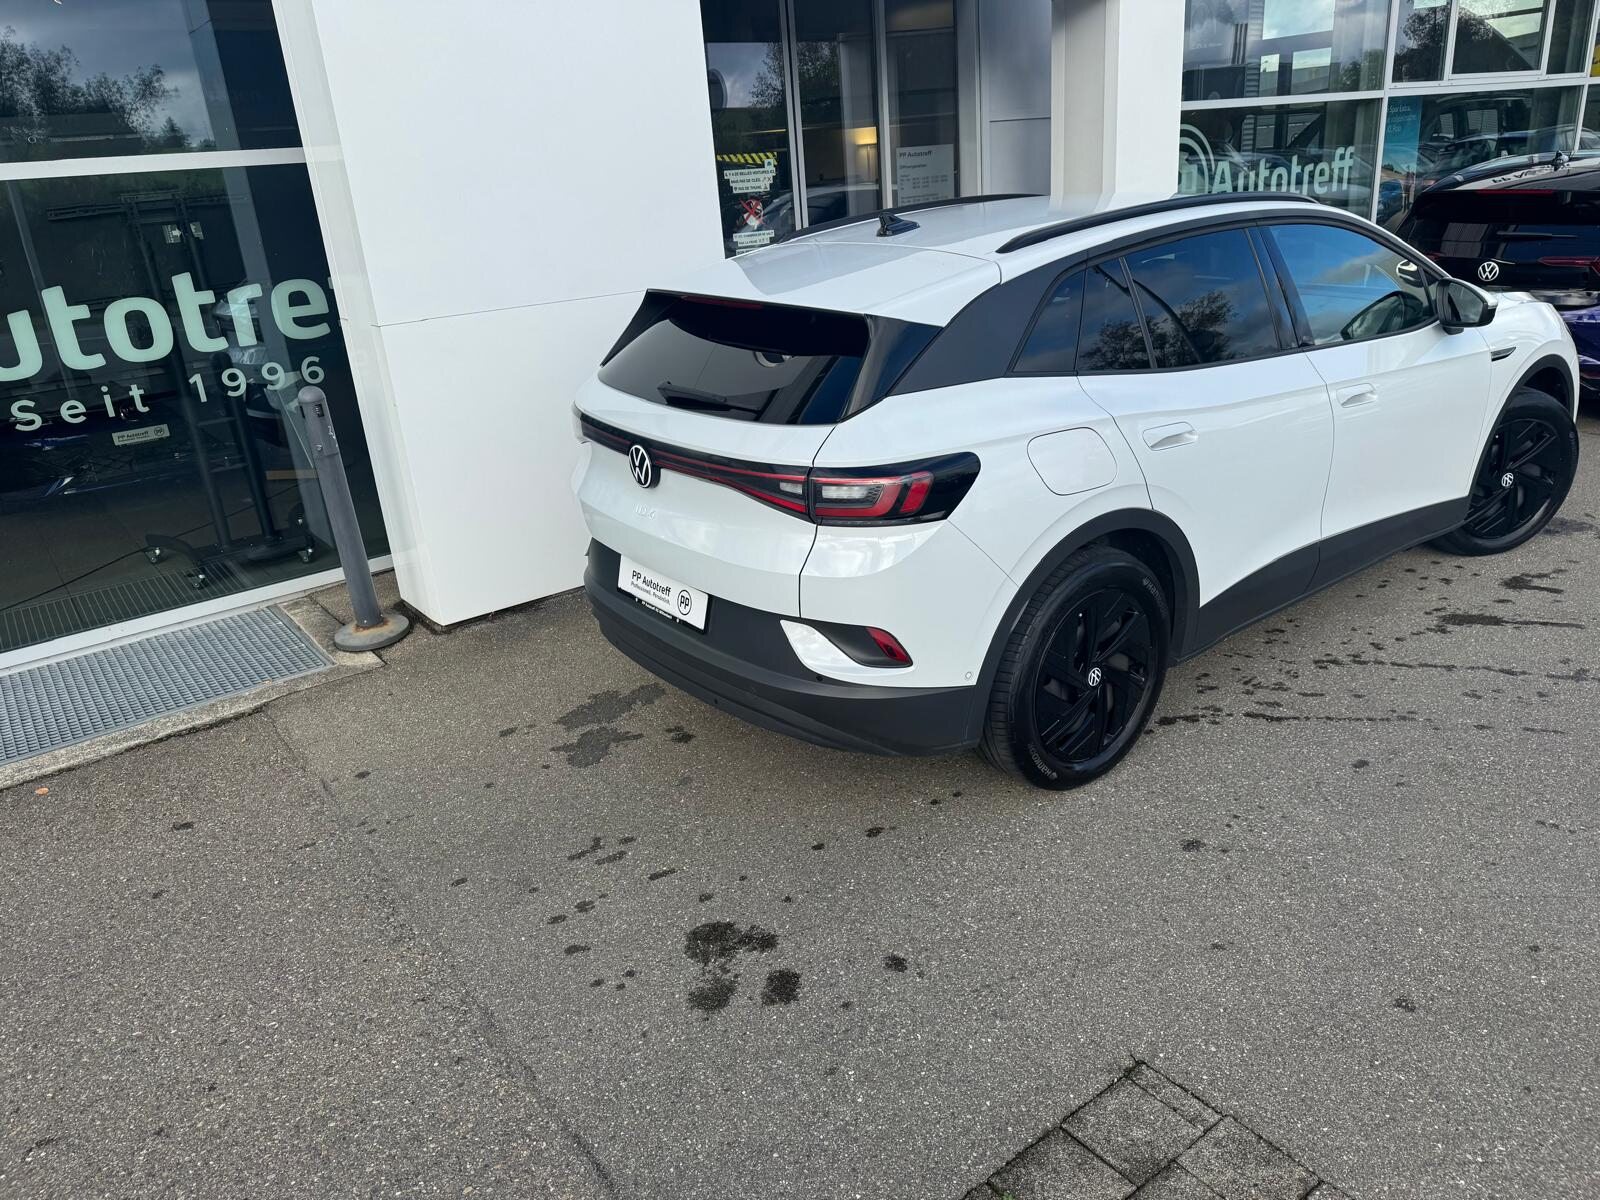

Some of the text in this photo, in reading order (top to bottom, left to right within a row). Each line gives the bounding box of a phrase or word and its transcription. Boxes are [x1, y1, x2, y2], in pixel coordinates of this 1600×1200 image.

[1212, 146, 1355, 195] Autotreff
[188, 356, 325, 403] 1996
[632, 570, 671, 597] PP Autotreff
